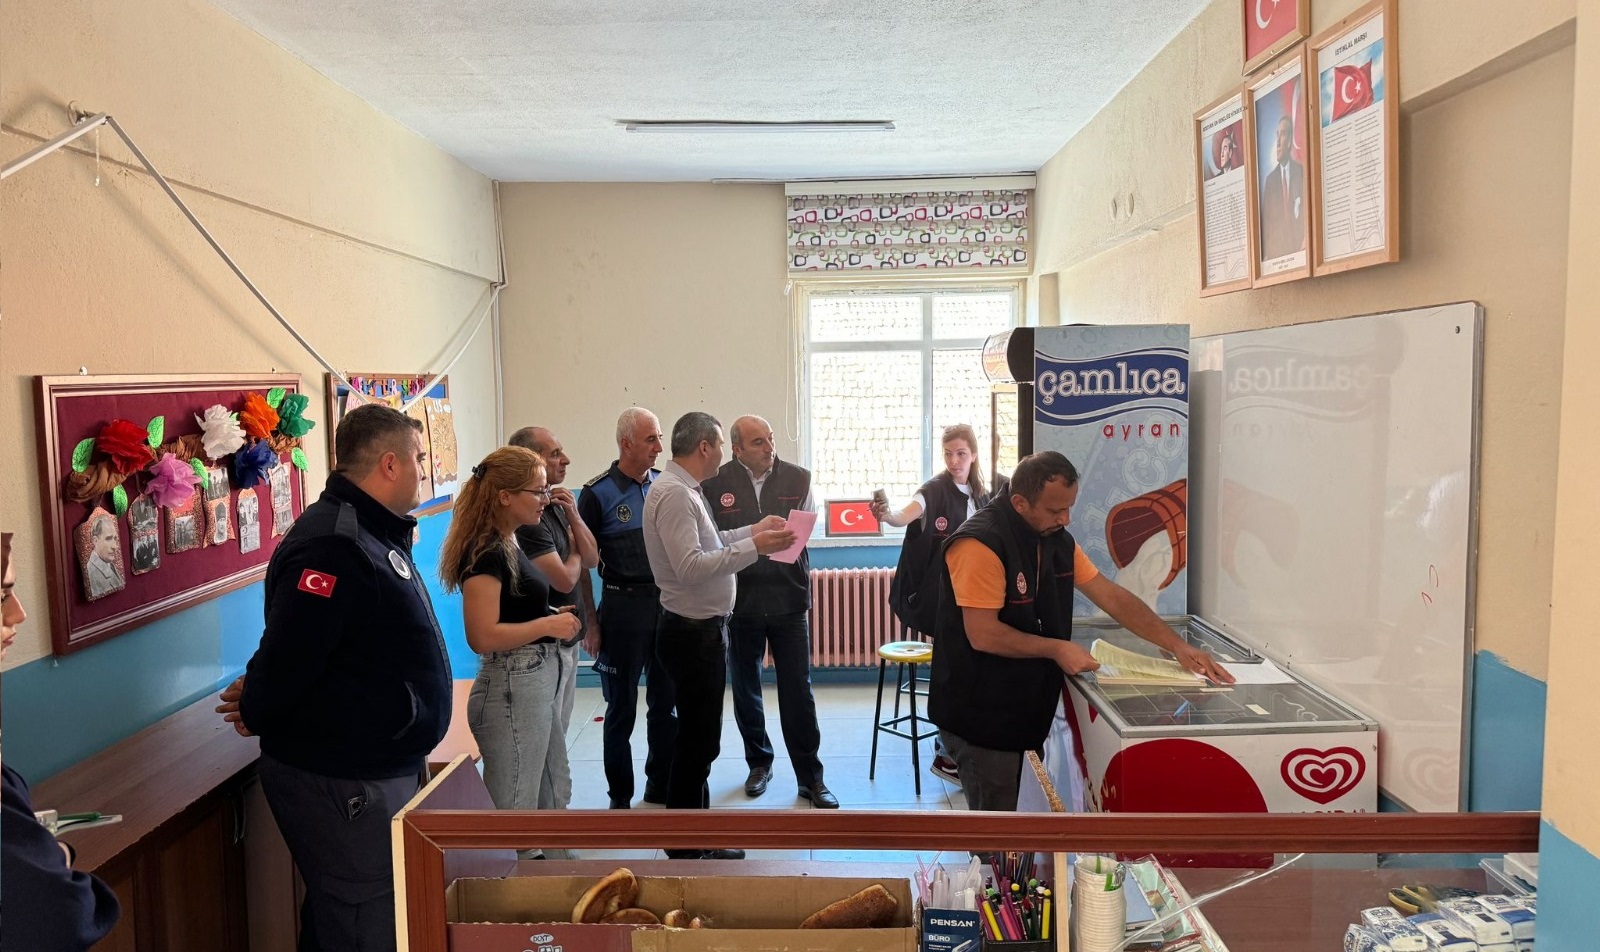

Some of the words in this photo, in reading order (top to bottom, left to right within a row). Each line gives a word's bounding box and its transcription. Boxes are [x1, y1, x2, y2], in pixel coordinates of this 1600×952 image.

[1038, 361, 1186, 406] çamlıca
[1103, 421, 1180, 441] ayran
[930, 918, 973, 928] PENSAN
